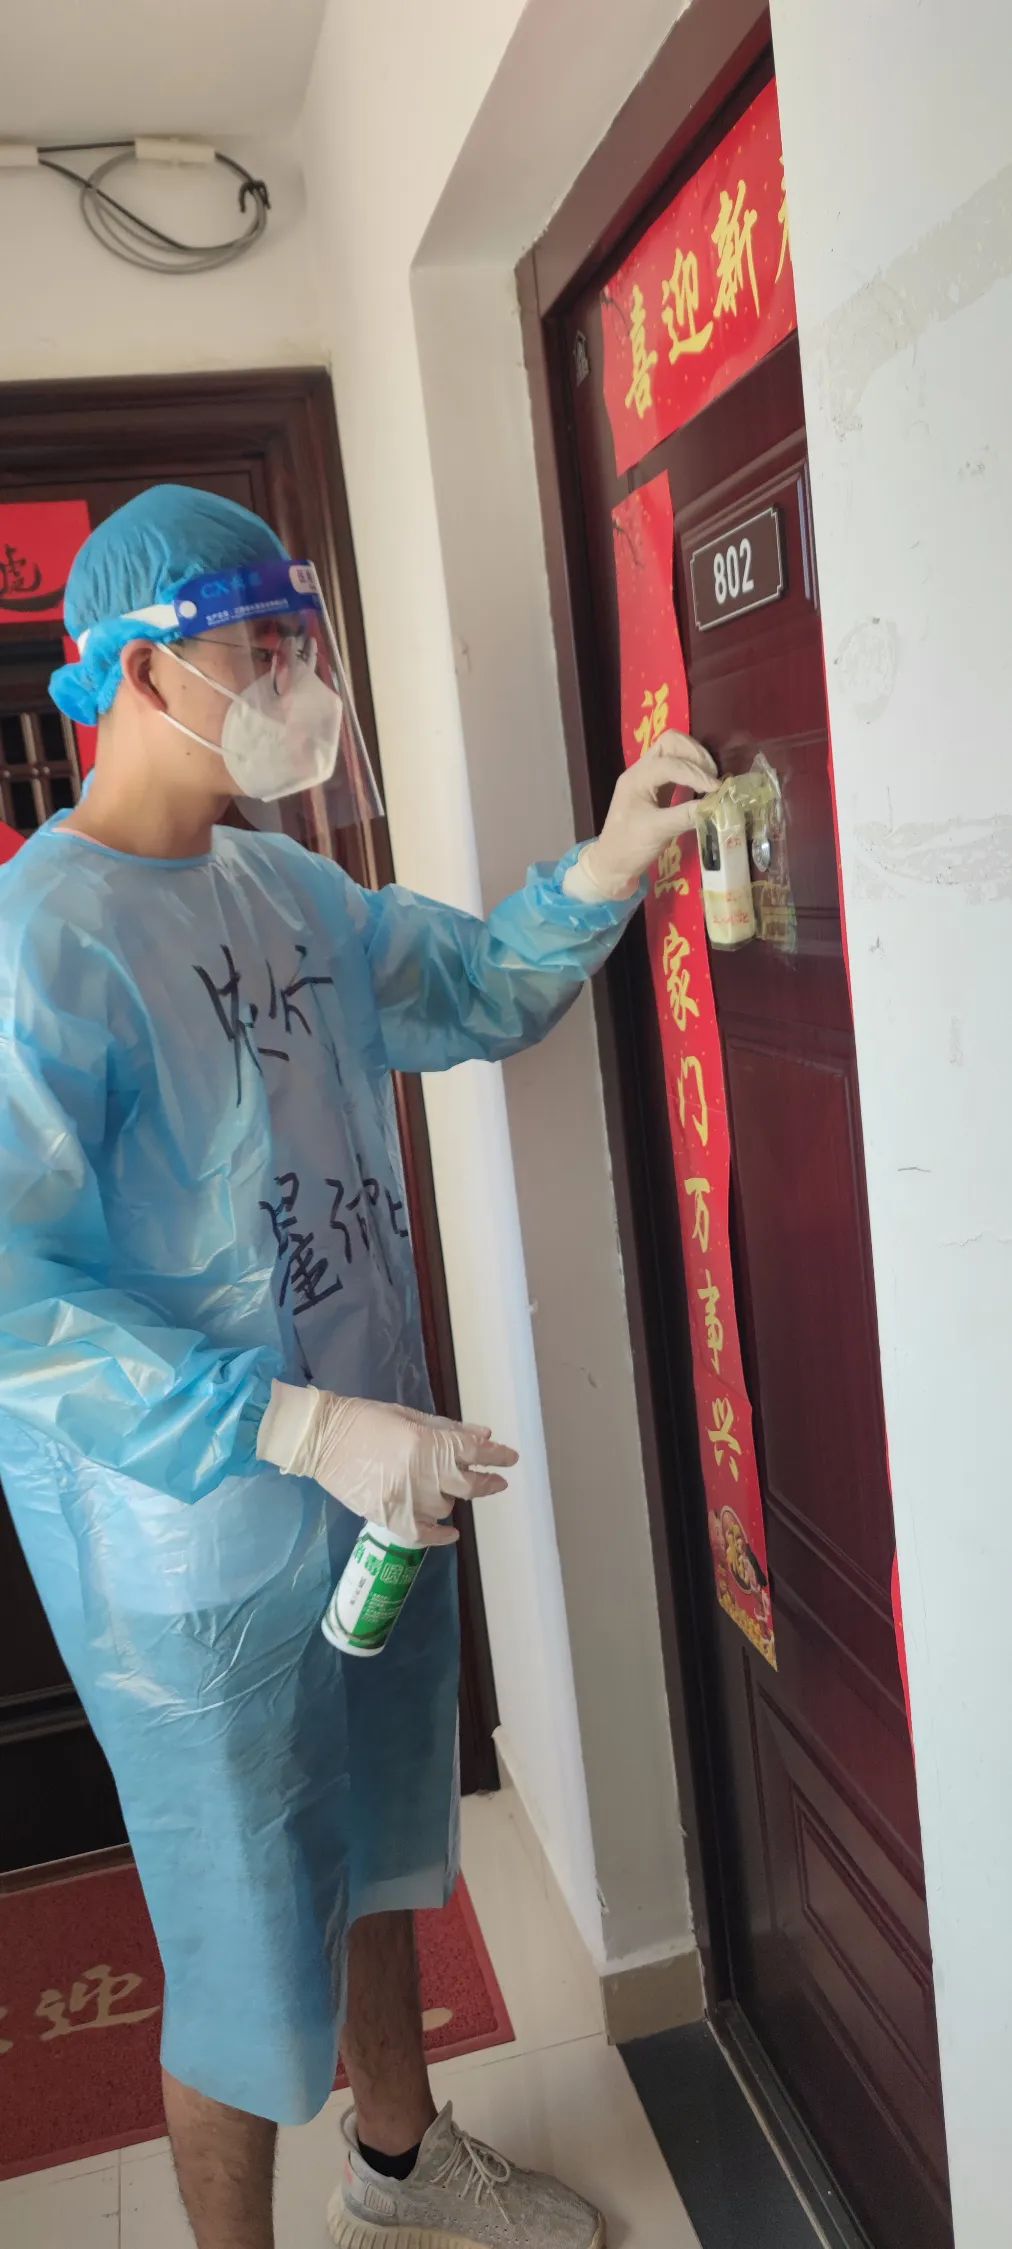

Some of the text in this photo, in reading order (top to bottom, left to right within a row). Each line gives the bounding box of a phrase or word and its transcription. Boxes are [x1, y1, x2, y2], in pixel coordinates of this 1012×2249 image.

[624, 153, 792, 420] 喜迎新
[713, 538, 754, 605] 802
